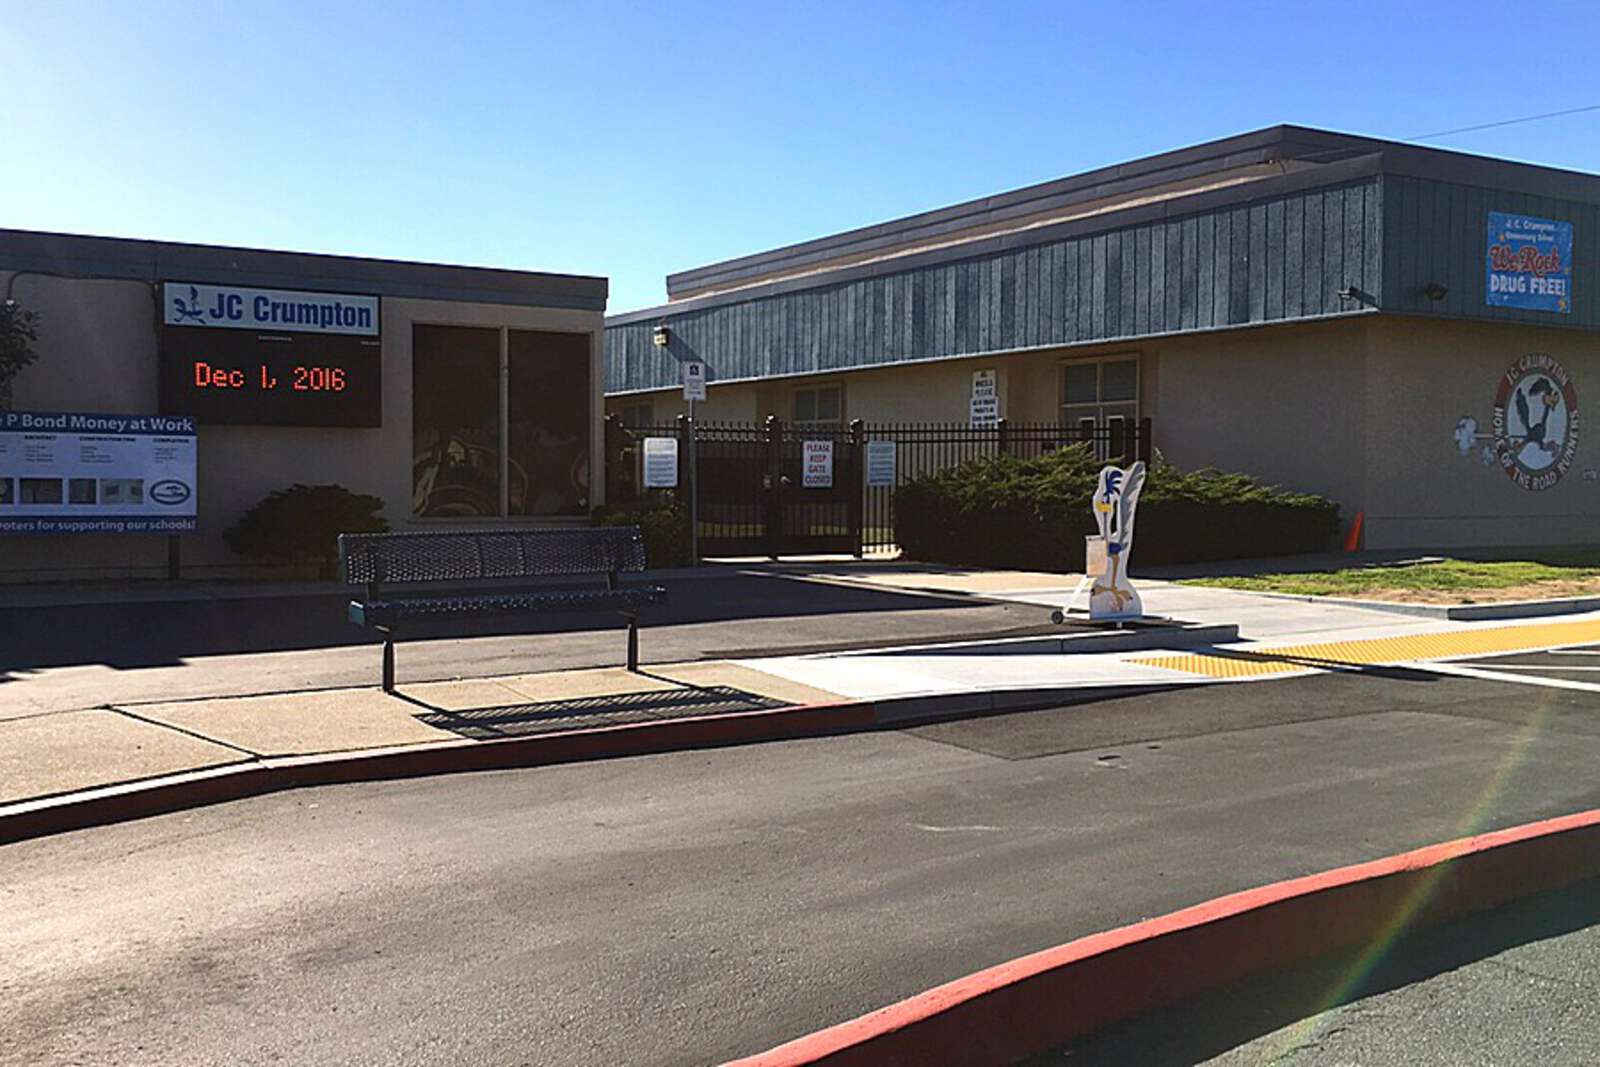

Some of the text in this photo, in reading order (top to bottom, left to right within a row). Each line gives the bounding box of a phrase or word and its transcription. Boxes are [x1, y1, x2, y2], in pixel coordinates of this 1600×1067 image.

[1488, 244, 1560, 278] We Rock
[1490, 274, 1566, 296] DRUG FREE!
[209, 292, 371, 328] JC Crumpton
[194, 361, 245, 388] Dec
[293, 367, 347, 391] 2016
[1520, 354, 1569, 386] CRUMPTON
[7, 414, 18, 427] P
[22, 414, 67, 428] Bond
[71, 415, 127, 432] Money
[130, 417, 147, 430] at
[150, 418, 193, 431] Work
[806, 442, 830, 452] PLEASE
[1500, 452, 1515, 468] OF
[1512, 467, 1531, 490] THE
[1531, 470, 1558, 490] ROAD
[1556, 409, 1580, 475] RUNNERS
[808, 464, 826, 473] GATE
[805, 475, 830, 485] CLOSED
[37, 519, 57, 531] for
[58, 519, 124, 533] supporting
[127, 522, 147, 531] our
[149, 519, 197, 532] schools!
